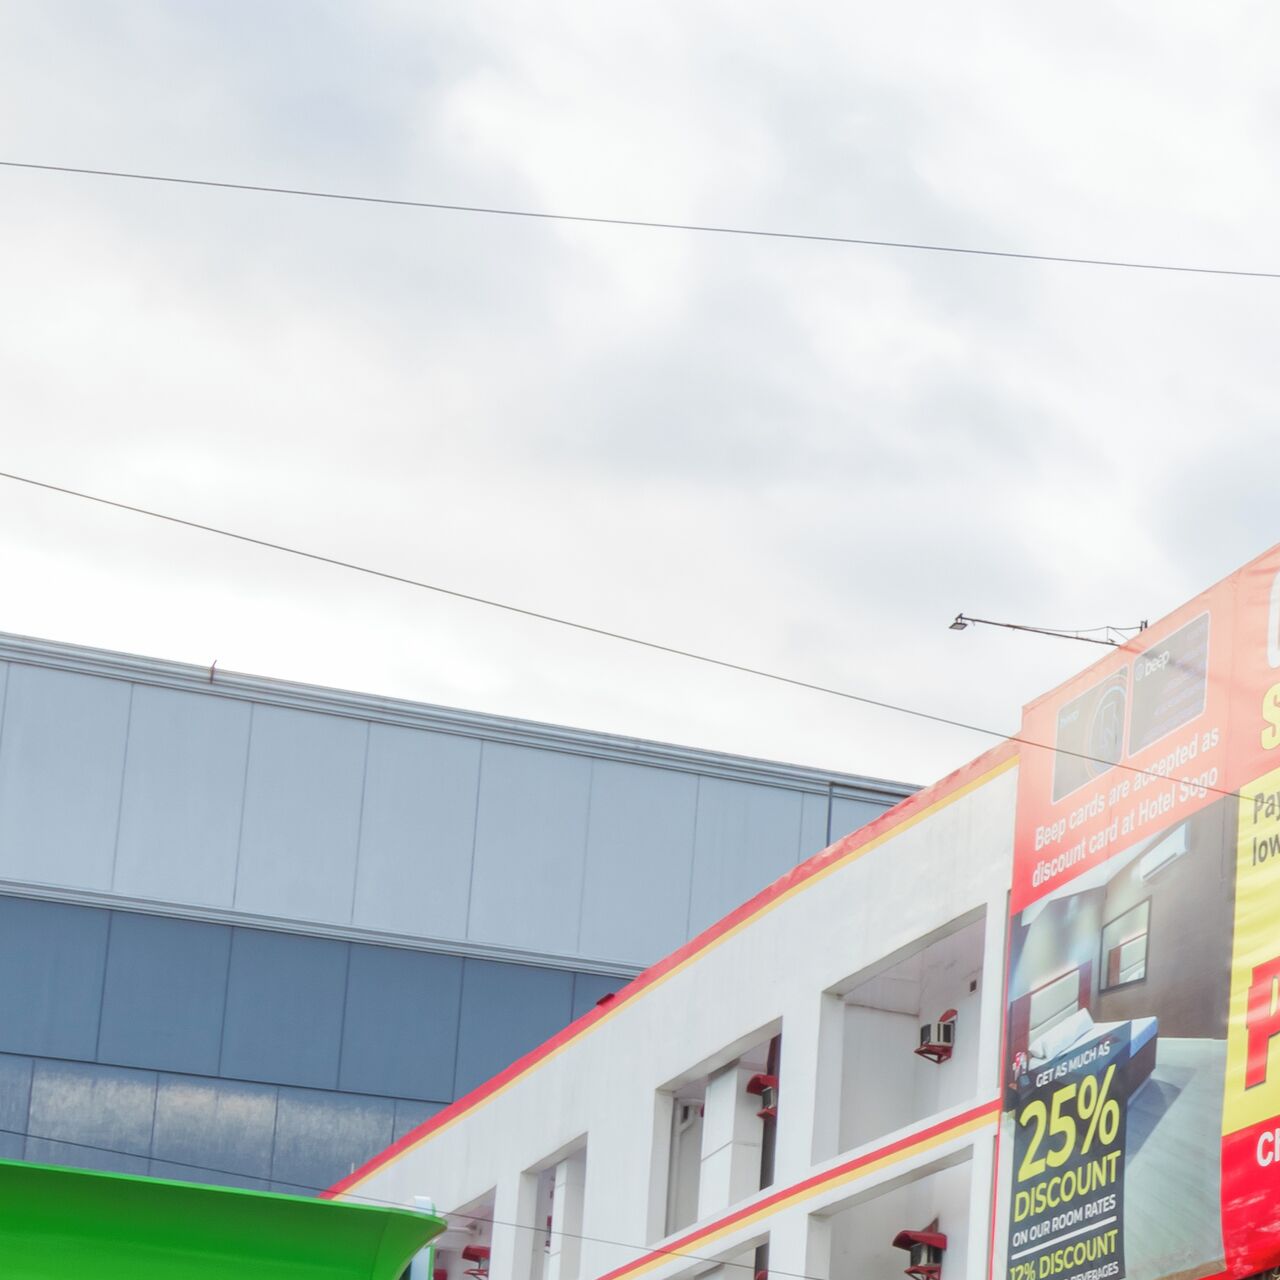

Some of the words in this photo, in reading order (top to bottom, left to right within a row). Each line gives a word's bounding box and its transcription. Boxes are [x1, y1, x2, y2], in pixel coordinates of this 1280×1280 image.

[1035, 815, 1066, 852] Beep
[1069, 793, 1105, 829] cards
[1109, 783, 1130, 807] are
[1133, 744, 1198, 791] accepted
[1201, 727, 1220, 753] as
[1032, 848, 1086, 888] discount
[1089, 825, 1118, 855] card
[1121, 817, 1136, 840] at
[1139, 787, 1176, 822] Hotel
[1179, 767, 1218, 805] Sogo
[1036, 1069, 1054, 1088] GET
[1054, 1063, 1068, 1080] AS
[1068, 1050, 1097, 1076] MUCH
[1097, 1041, 1110, 1060] AS
[1017, 1063, 1120, 1183] 25%
[1012, 1228, 1028, 1248] ON
[1029, 1219, 1050, 1242] OUR
[1052, 1207, 1083, 1236] ROOM
[1084, 1194, 1116, 1225] RATES
[1014, 1150, 1122, 1222] DISCOUNT
[1039, 1229, 1118, 1277] DISCOUNT
